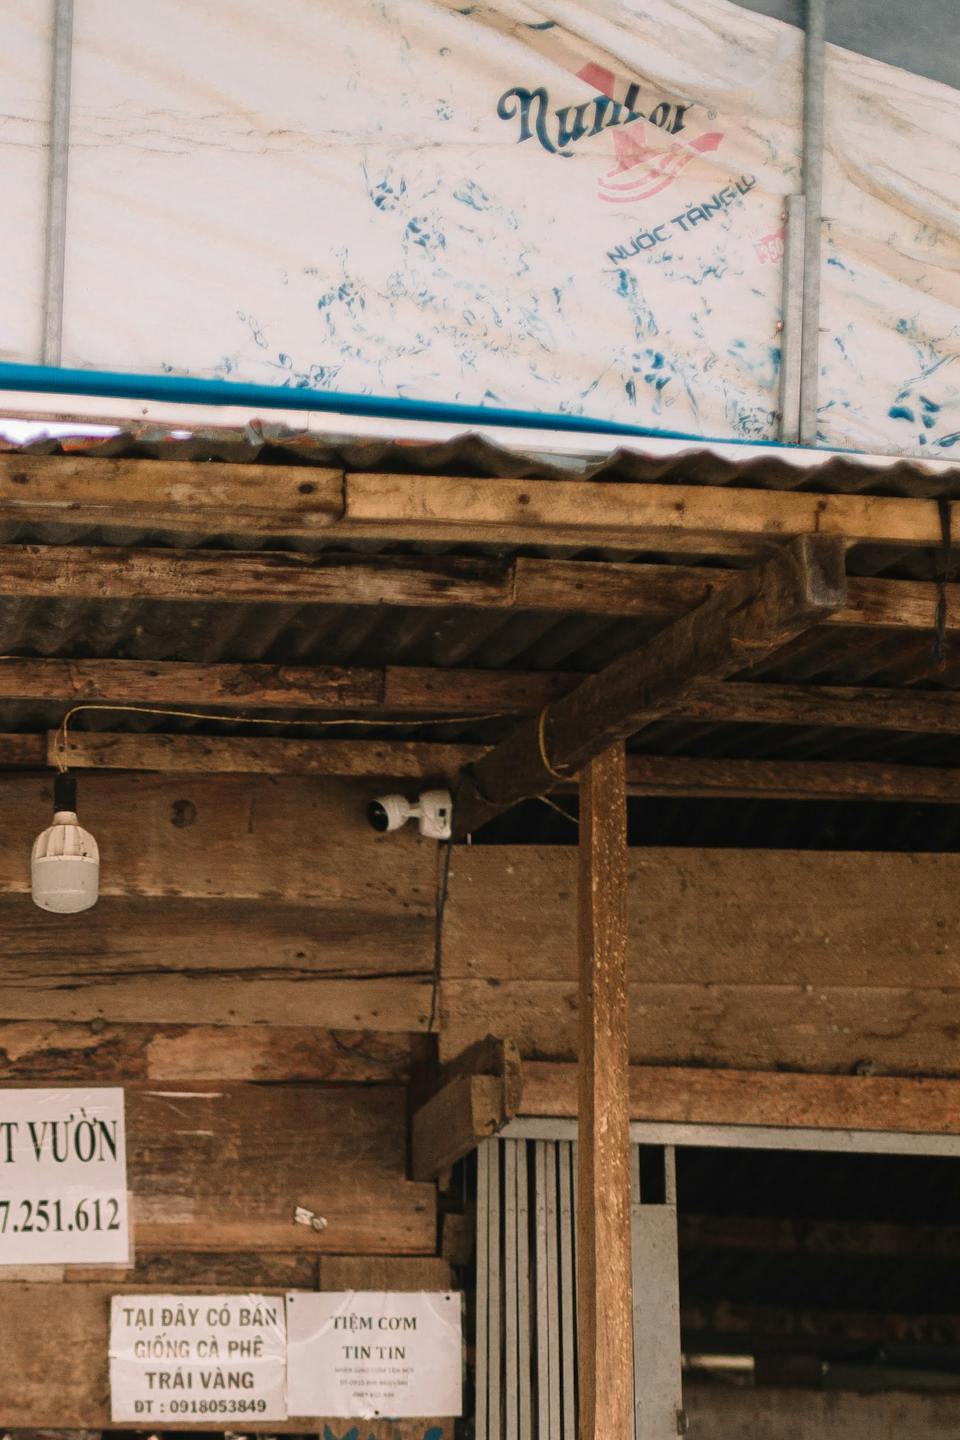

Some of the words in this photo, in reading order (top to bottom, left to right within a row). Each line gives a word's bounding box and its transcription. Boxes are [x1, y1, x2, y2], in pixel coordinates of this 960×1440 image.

[26, 1107, 117, 1163] VƯỜN
[122, 1308, 154, 1331] TẠI
[161, 1303, 200, 1327] ĐÂY
[207, 1303, 231, 1327] CÓ
[330, 1312, 373, 1333] TIỆM
[378, 1315, 417, 1331] CƠM
[134, 1333, 190, 1359] GIỐNG
[197, 1334, 220, 1359] CÀ
[228, 1335, 264, 1358] PHÊ
[342, 1345, 371, 1359] TIN
[376, 1345, 406, 1360] TIN
[144, 1367, 192, 1389] TRÁI
[200, 1367, 255, 1389] VÀNG
[170, 1400, 267, 1413] 0918053849
